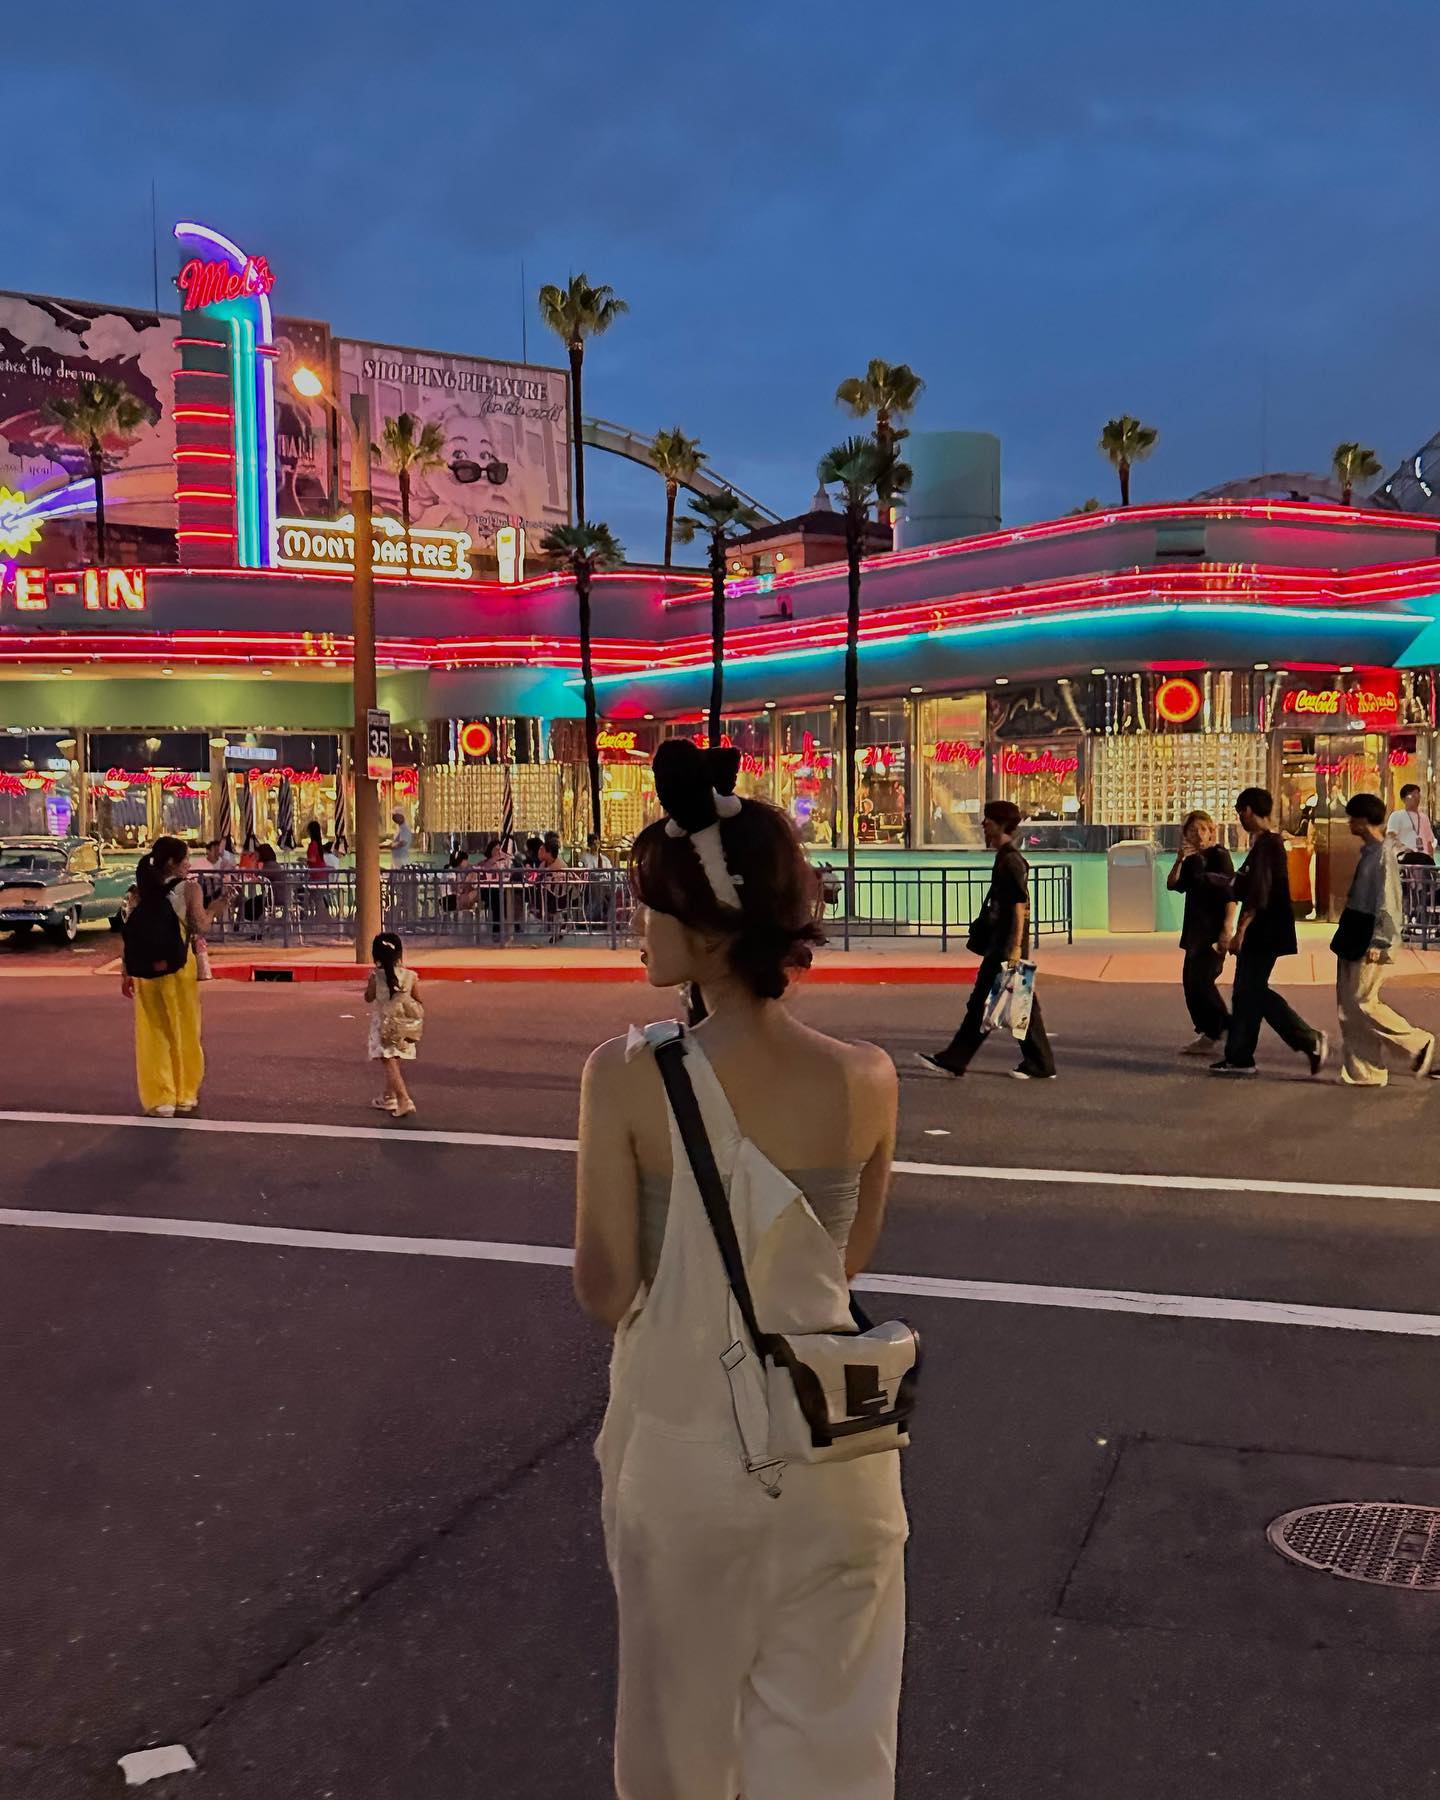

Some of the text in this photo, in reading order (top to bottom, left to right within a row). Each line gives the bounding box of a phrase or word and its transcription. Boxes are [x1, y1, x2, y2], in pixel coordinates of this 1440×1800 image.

[179, 255, 276, 311] Mel's
[32, 356, 52, 376] the
[363, 359, 548, 400] SHOPPING PLEASURE
[370, 729, 389, 758] 35
